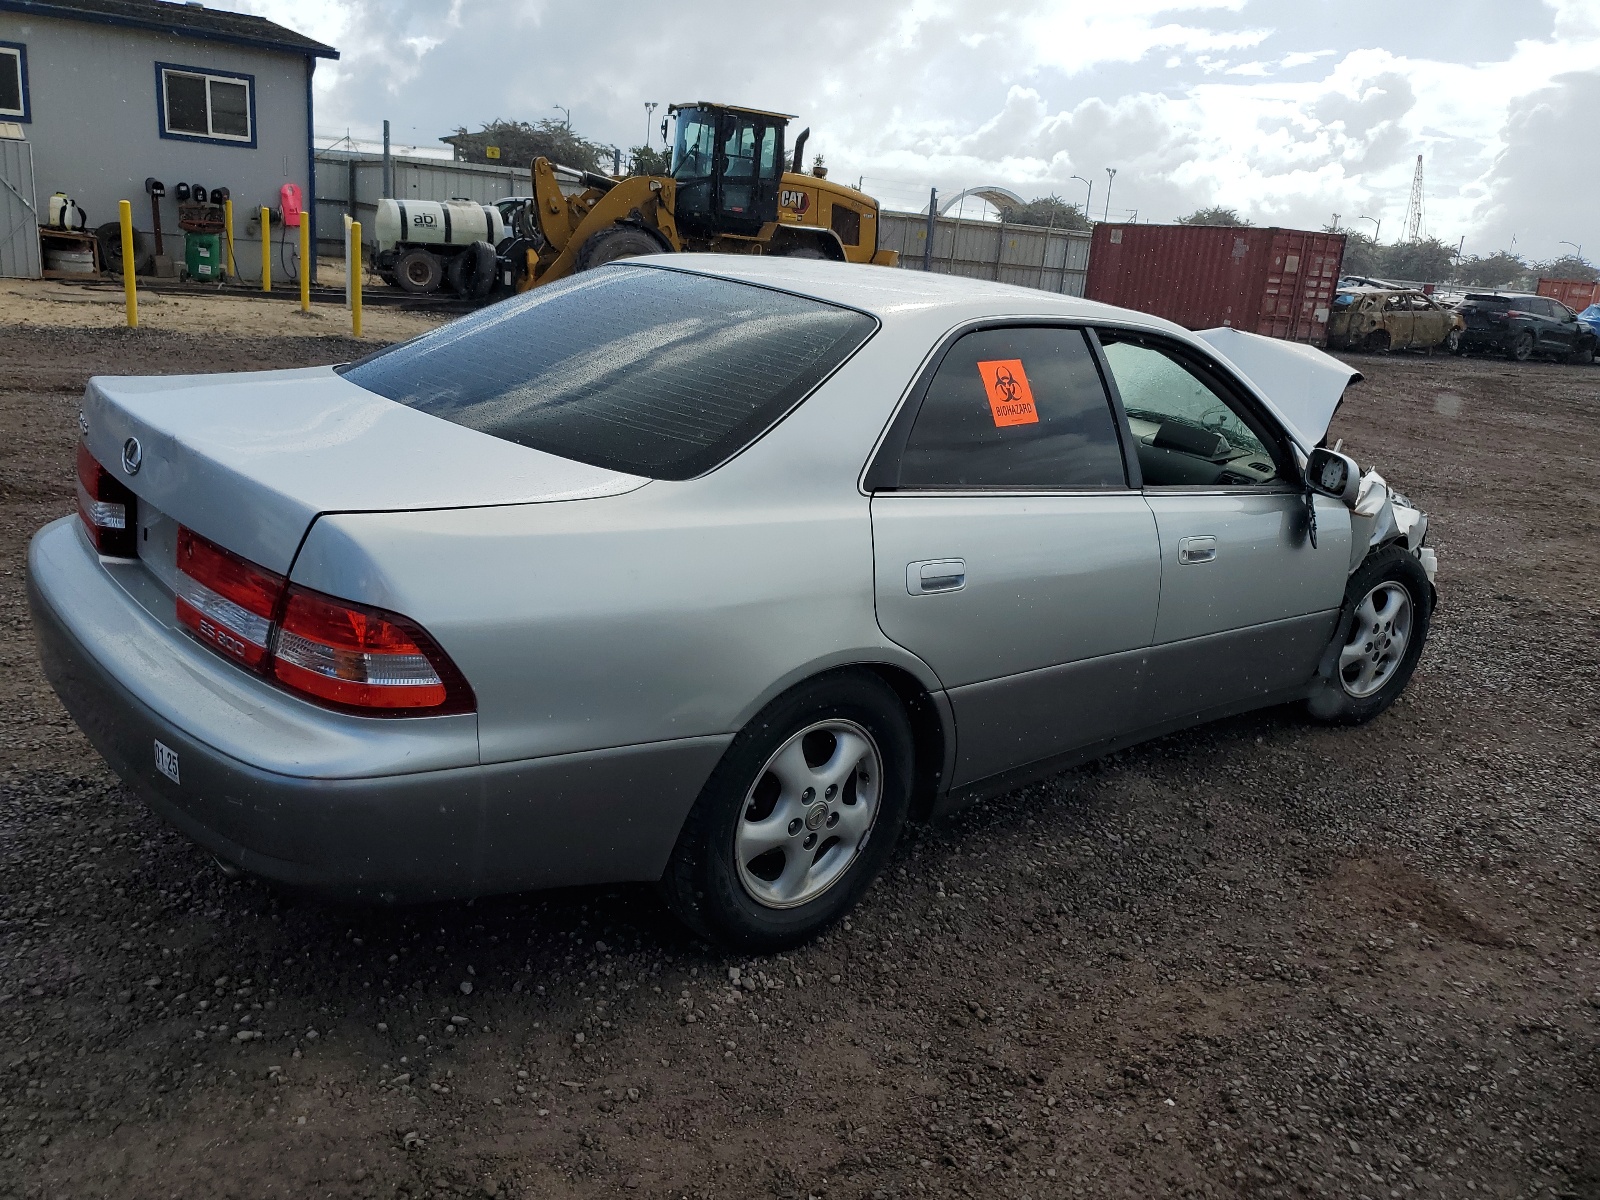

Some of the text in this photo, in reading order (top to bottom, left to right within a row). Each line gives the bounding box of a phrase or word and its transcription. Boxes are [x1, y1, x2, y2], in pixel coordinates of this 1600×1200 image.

[781, 190, 804, 210] CAT
[995, 403, 1033, 417] BIOHAZARD
[155, 743, 178, 776] 01 25
